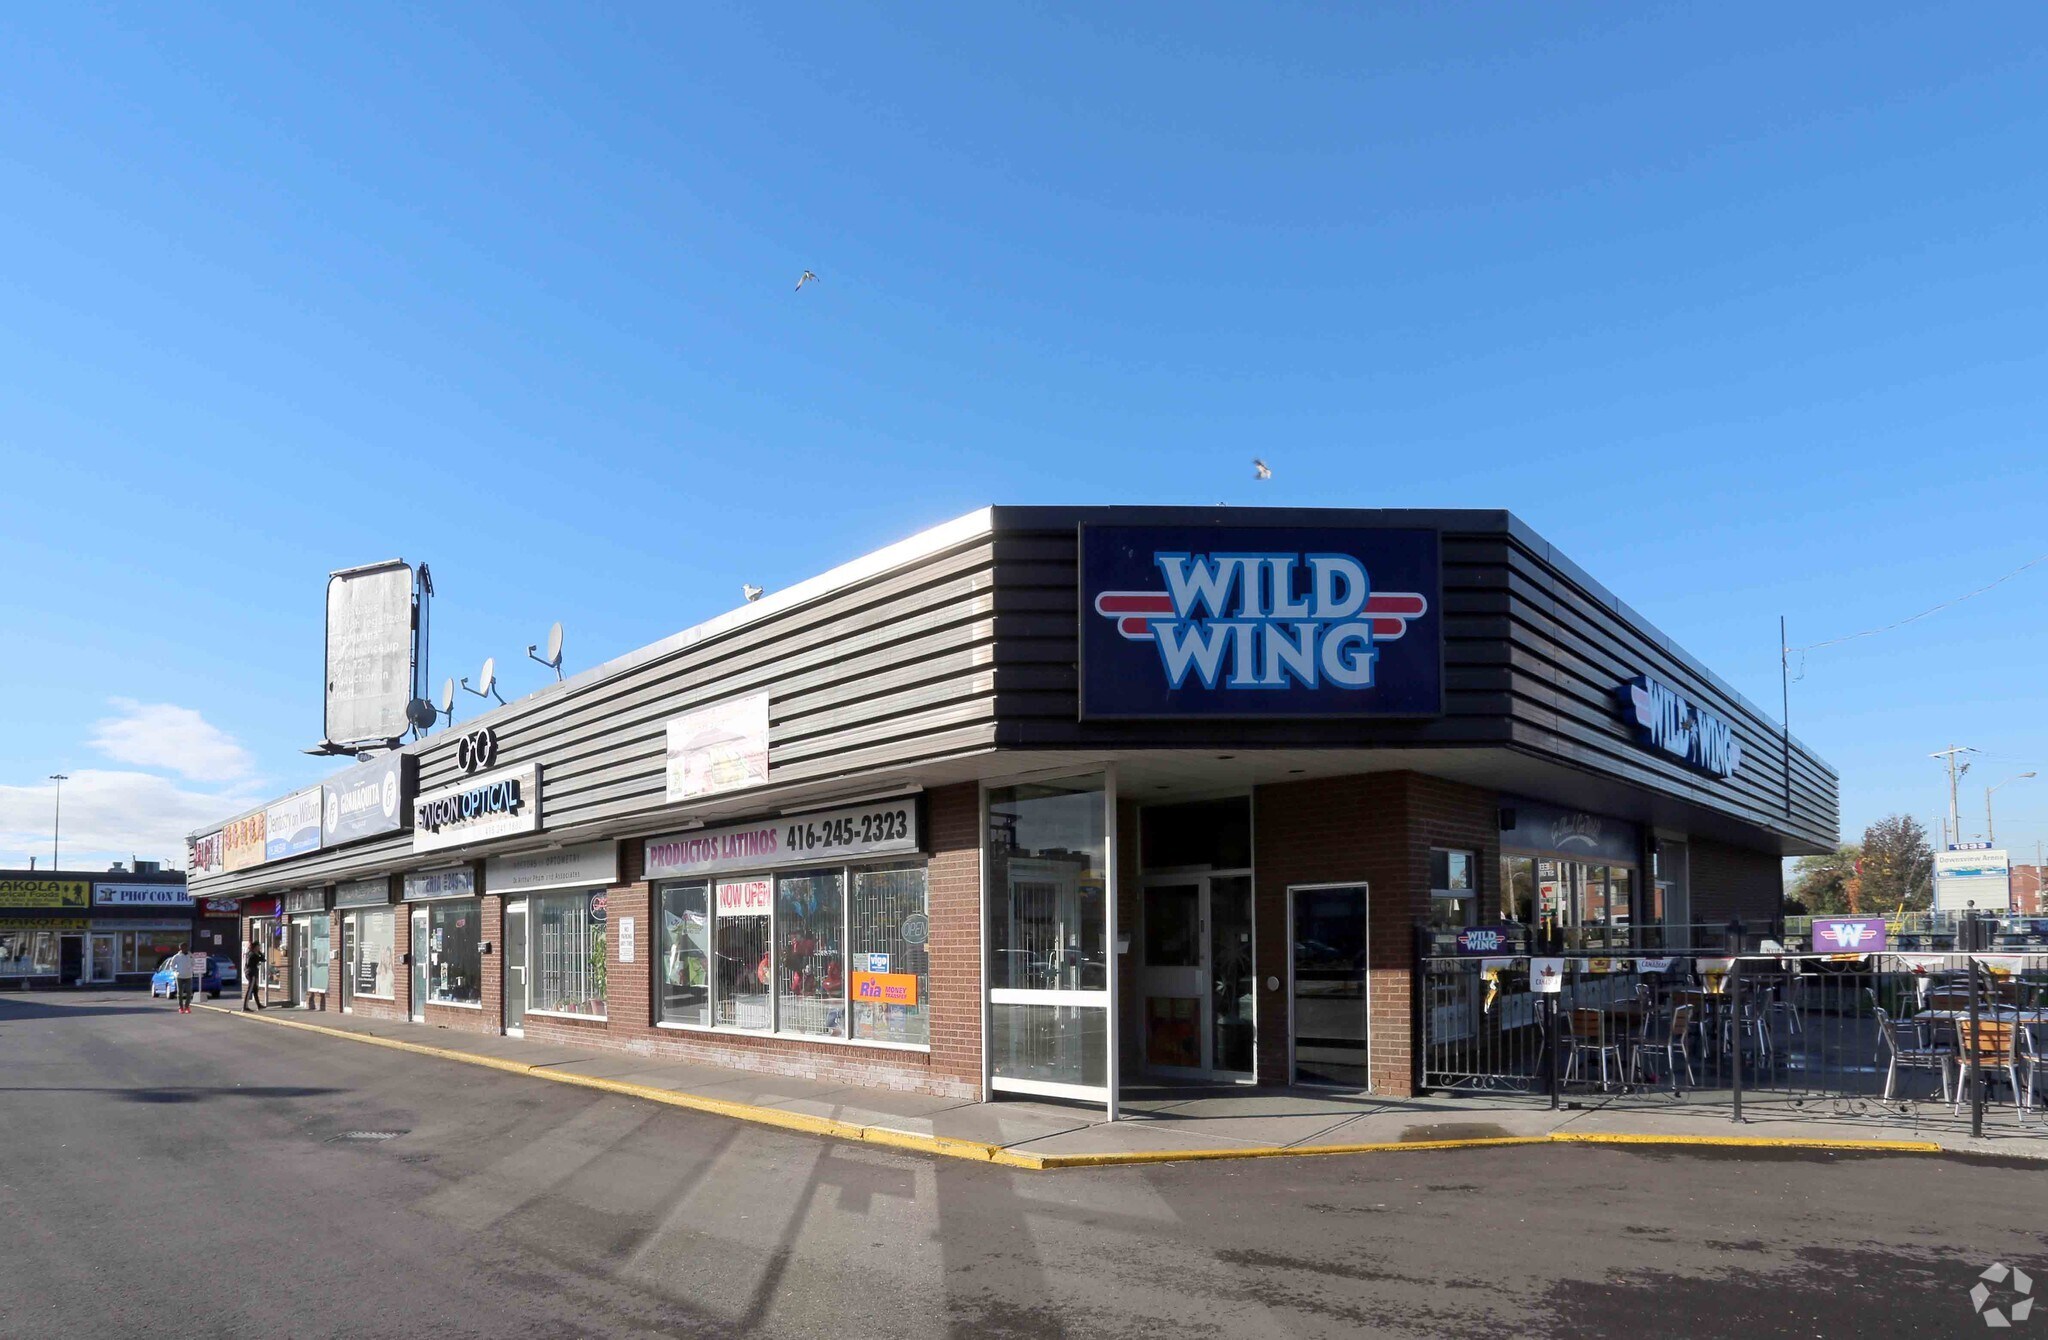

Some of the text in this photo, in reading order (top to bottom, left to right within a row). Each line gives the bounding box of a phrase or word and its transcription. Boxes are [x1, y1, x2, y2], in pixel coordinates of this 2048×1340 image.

[1154, 552, 1370, 619] WILD
[1149, 619, 1378, 689] WING
[1645, 676, 1732, 778] WILD WING
[418, 778, 518, 832] SAIGON OPTICAL
[650, 810, 907, 868] PRODUCTOS LATINOS 416-245-2323
[545, 853, 580, 866] OPTOMETRY
[532, 874, 545, 882] Pham
[555, 871, 580, 880] Associates
[719, 880, 770, 907] NOW OPEN
[904, 921, 928, 937] OPEN
[1467, 931, 1497, 941] WILD
[1830, 923, 1866, 947] W
[1467, 941, 1498, 950] WING
[870, 954, 887, 967] vigo
[860, 977, 882, 998] Ria
[885, 986, 907, 994] MONEY
